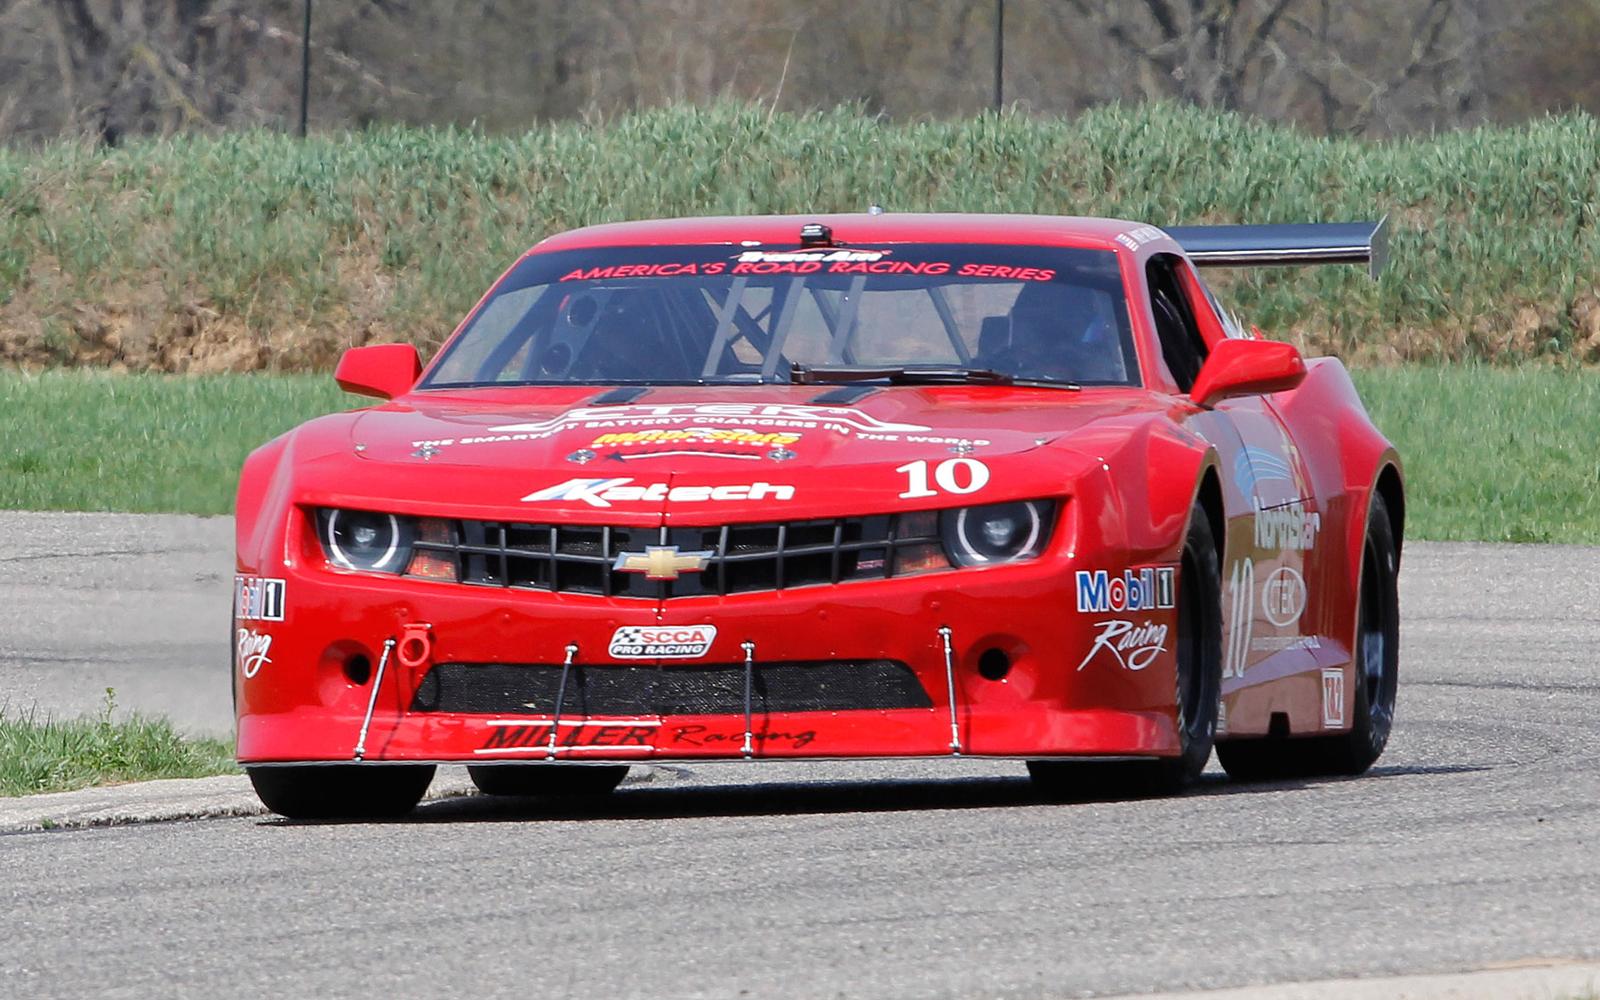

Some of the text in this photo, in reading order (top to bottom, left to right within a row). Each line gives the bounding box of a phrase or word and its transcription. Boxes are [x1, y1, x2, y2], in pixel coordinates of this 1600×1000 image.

[559, 261, 1057, 282] AMERICA'S ROAD RACING SERIES
[567, 405, 825, 418] CTEK
[412, 440, 455, 448] THE
[585, 417, 687, 428] BATTERY
[693, 416, 817, 429] CHARGERS
[824, 422, 850, 434] IN
[857, 432, 899, 441] THE
[907, 435, 990, 446] WORLD
[521, 478, 794, 507] Katech
[896, 458, 991, 499] 10
[1076, 567, 1175, 612] Mobil 1
[1222, 557, 1254, 678] 10
[613, 645, 703, 654] PRO RACING
[641, 631, 706, 643] SCCA
[1077, 620, 1168, 671] Racing
[484, 726, 657, 748] MILLER
